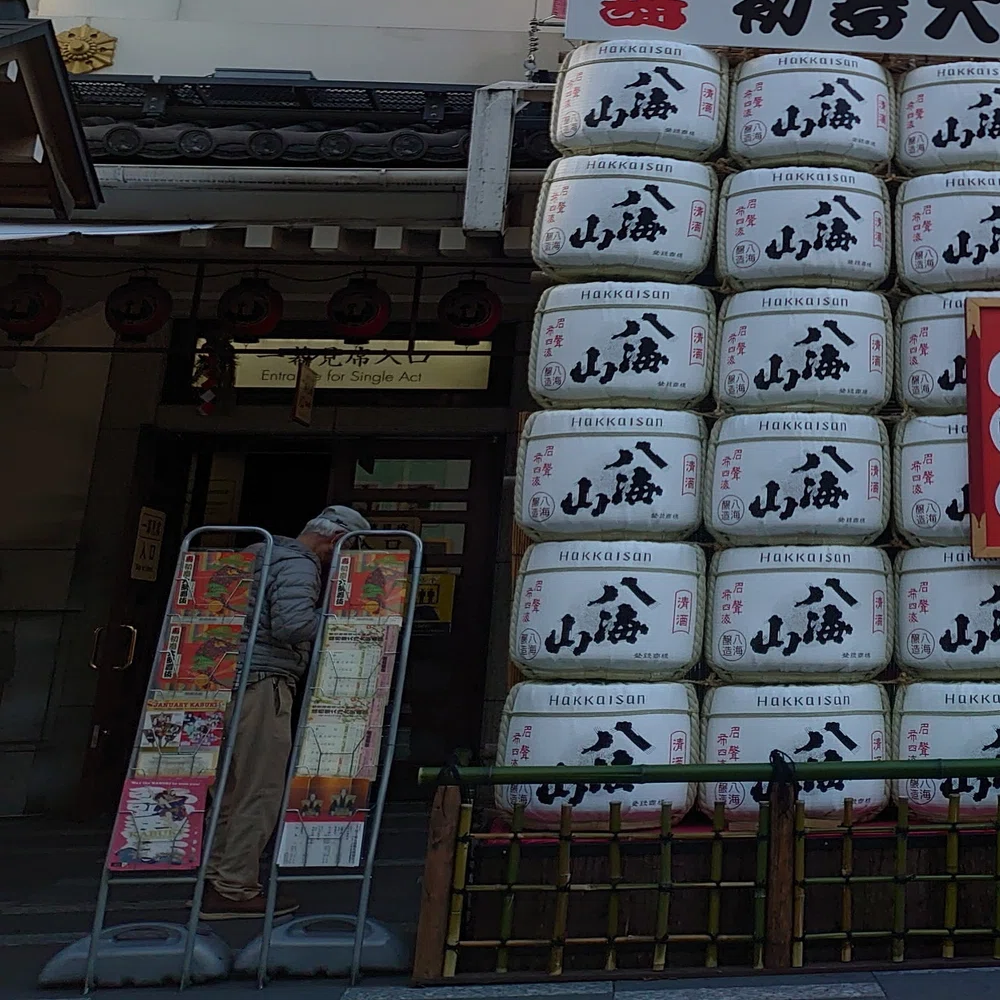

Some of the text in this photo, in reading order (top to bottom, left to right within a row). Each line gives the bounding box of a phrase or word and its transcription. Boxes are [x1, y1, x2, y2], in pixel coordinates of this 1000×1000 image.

[261, 369, 422, 385] Entrae for Single Act
